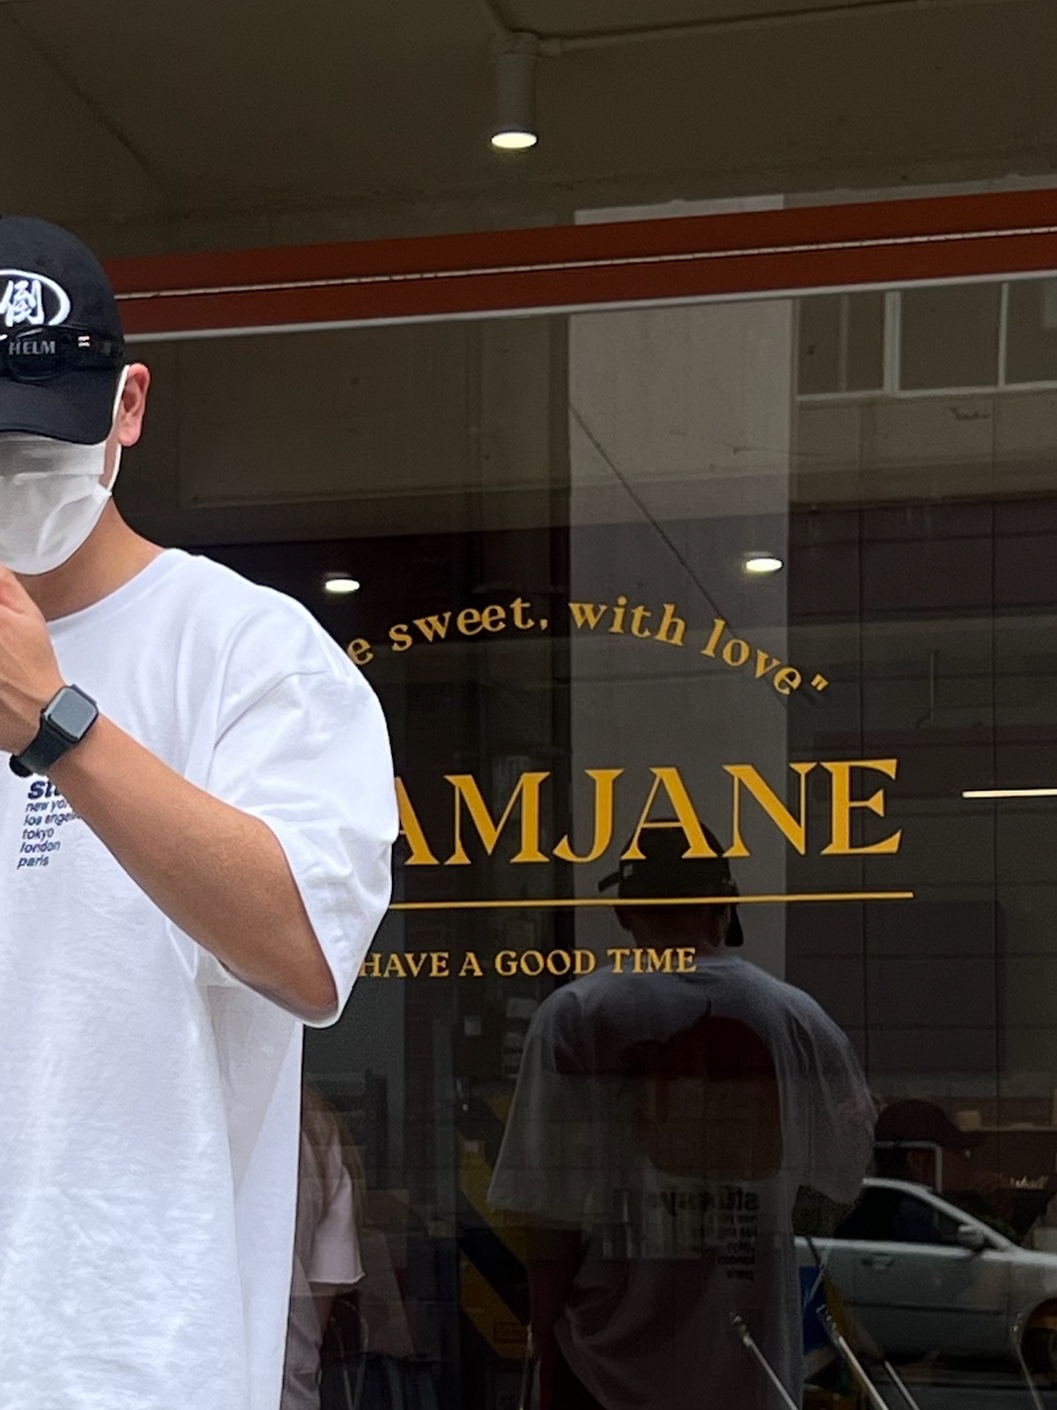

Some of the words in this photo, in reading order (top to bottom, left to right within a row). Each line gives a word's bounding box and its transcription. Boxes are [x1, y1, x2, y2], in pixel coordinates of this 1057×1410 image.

[388, 596, 549, 652] sweet,
[568, 595, 686, 647] with
[700, 618, 829, 695] love"
[22, 827, 55, 842] tokyo
[20, 840, 61, 853] london
[17, 854, 50, 870] paris
[359, 950, 449, 978] HAVE
[458, 949, 483, 977] A
[495, 948, 596, 976] GOOD
[607, 946, 698, 974] TIME
